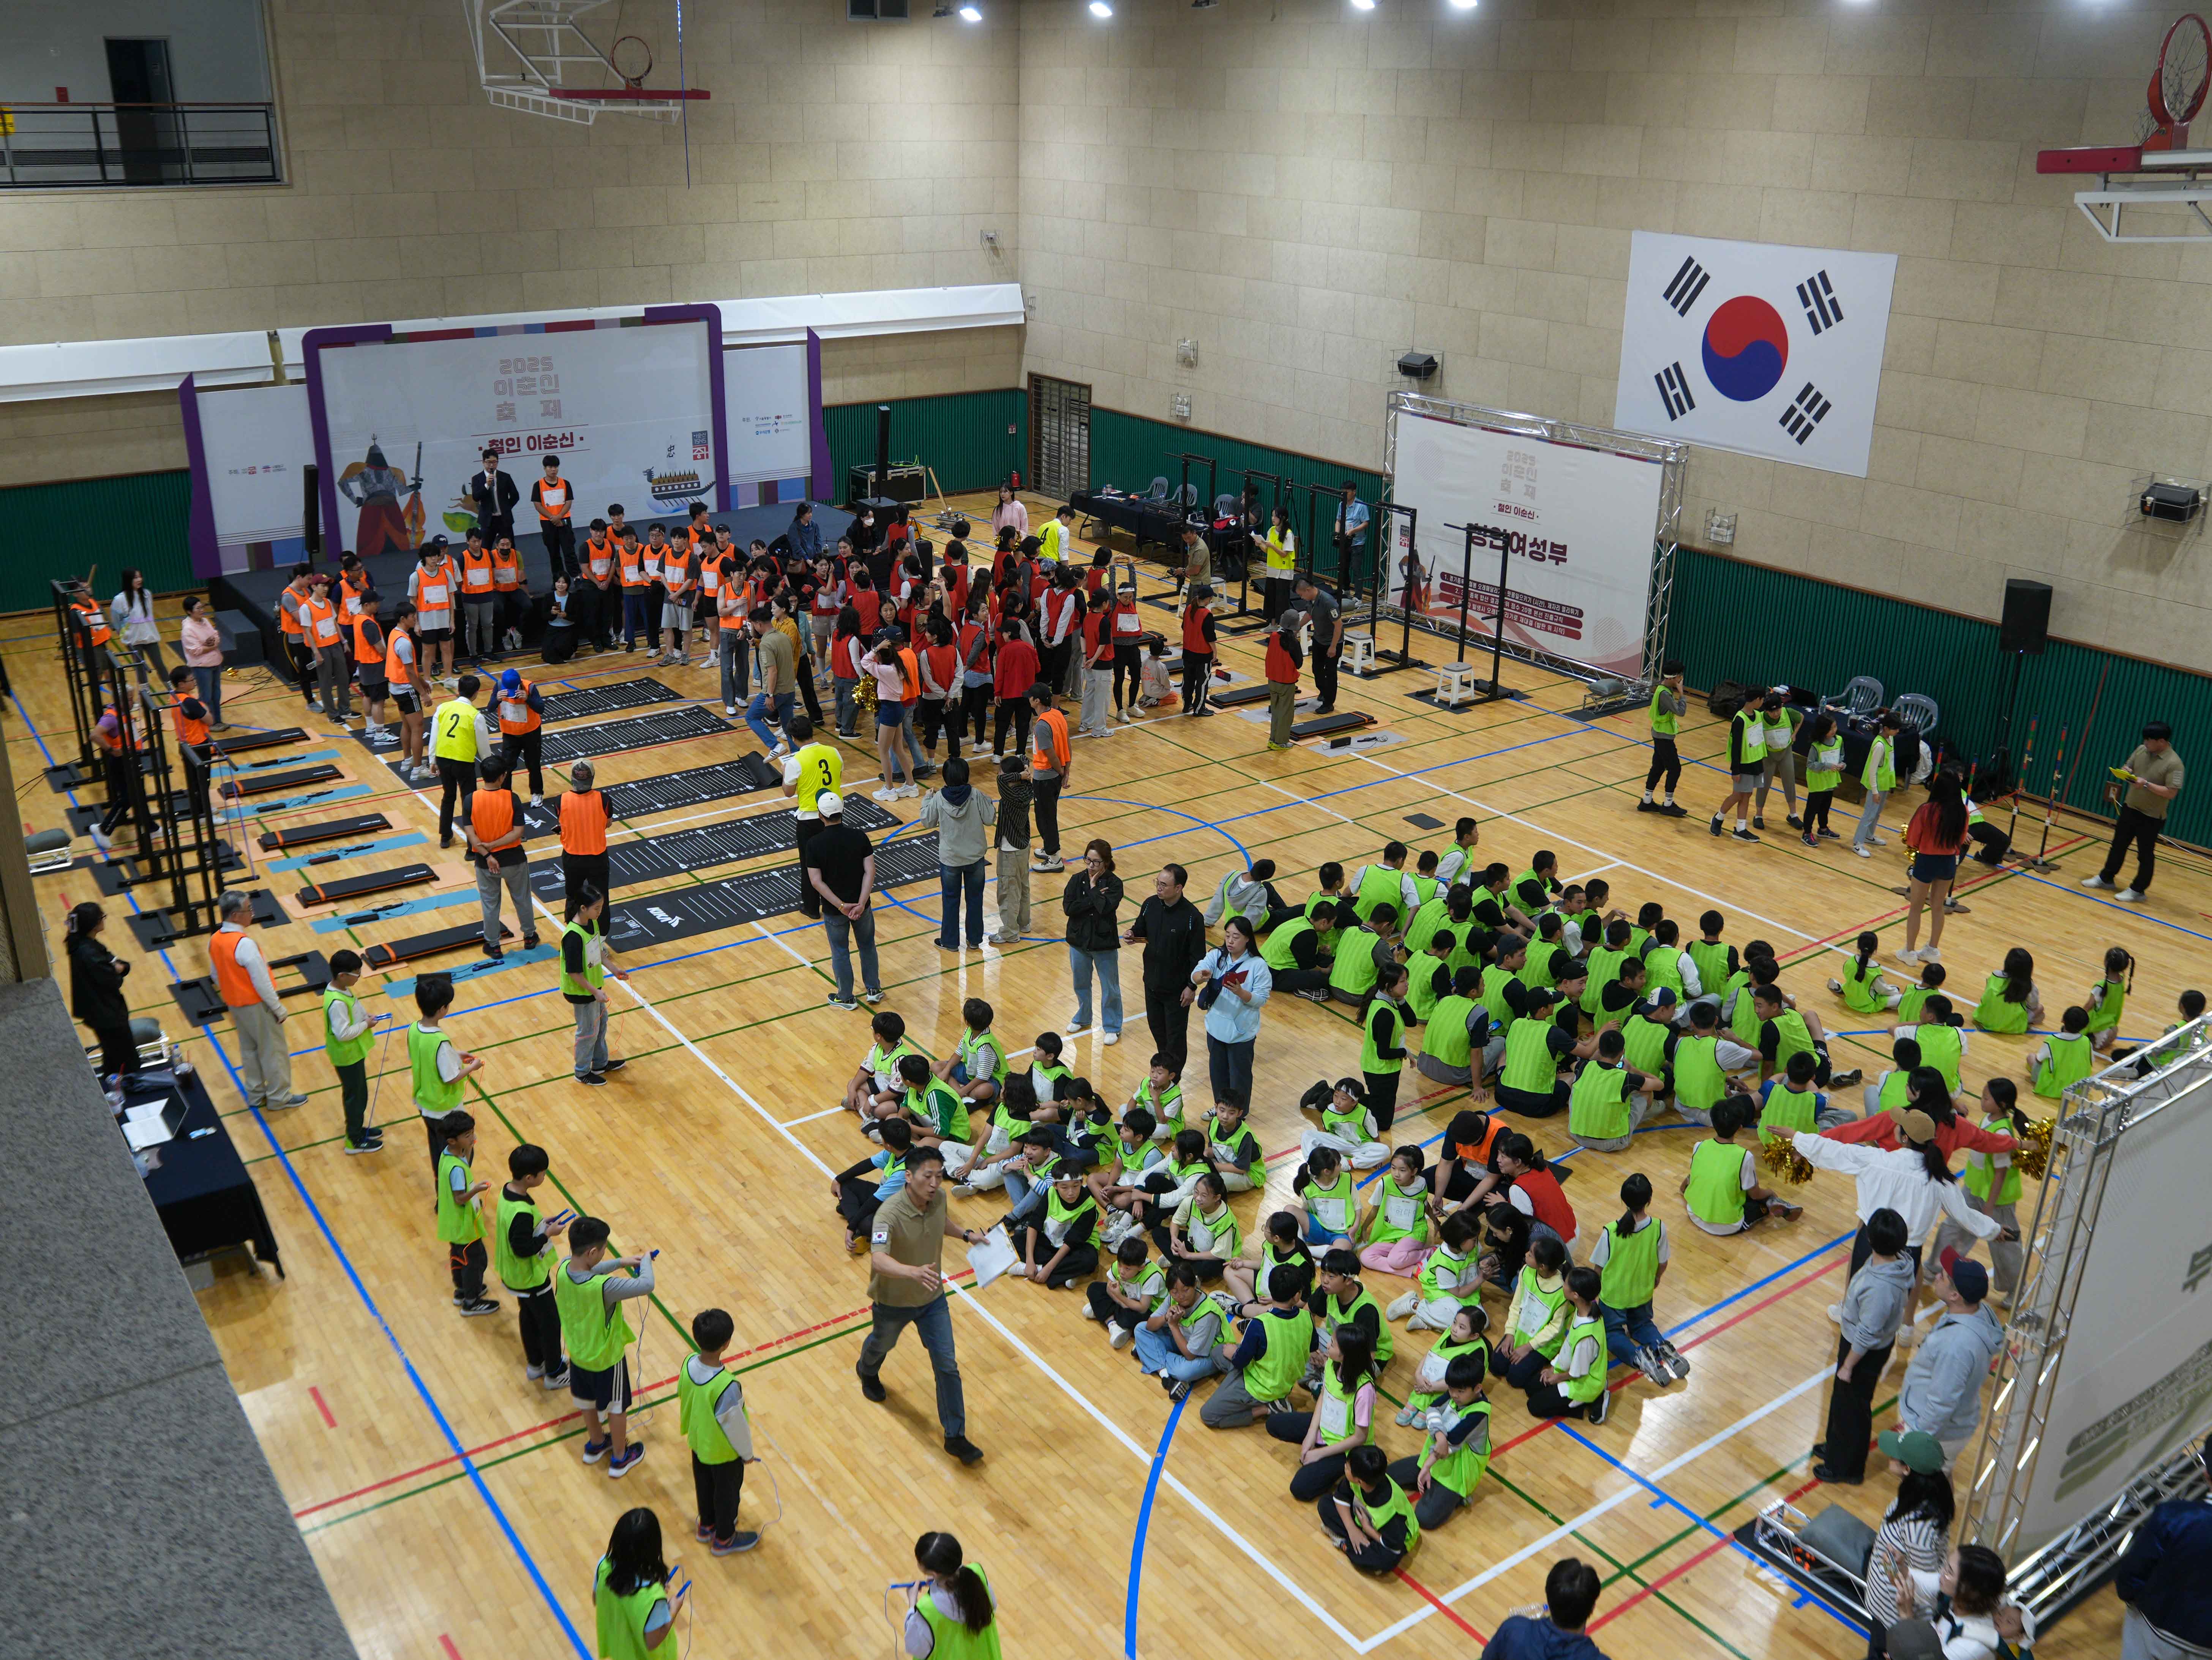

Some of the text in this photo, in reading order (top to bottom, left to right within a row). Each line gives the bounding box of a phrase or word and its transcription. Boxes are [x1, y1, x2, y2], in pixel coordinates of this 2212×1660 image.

[500, 356, 553, 374] 2025
[494, 374, 559, 396] 이순신
[489, 432, 574, 454] 철인 이순신
[1507, 450, 1536, 466] 2025
[1498, 503, 1535, 520] 철인 이순신
[1040, 527, 1049, 544] 4
[447, 713, 459, 738] 2
[818, 759, 832, 786] 3
[625, 920, 641, 929] START
